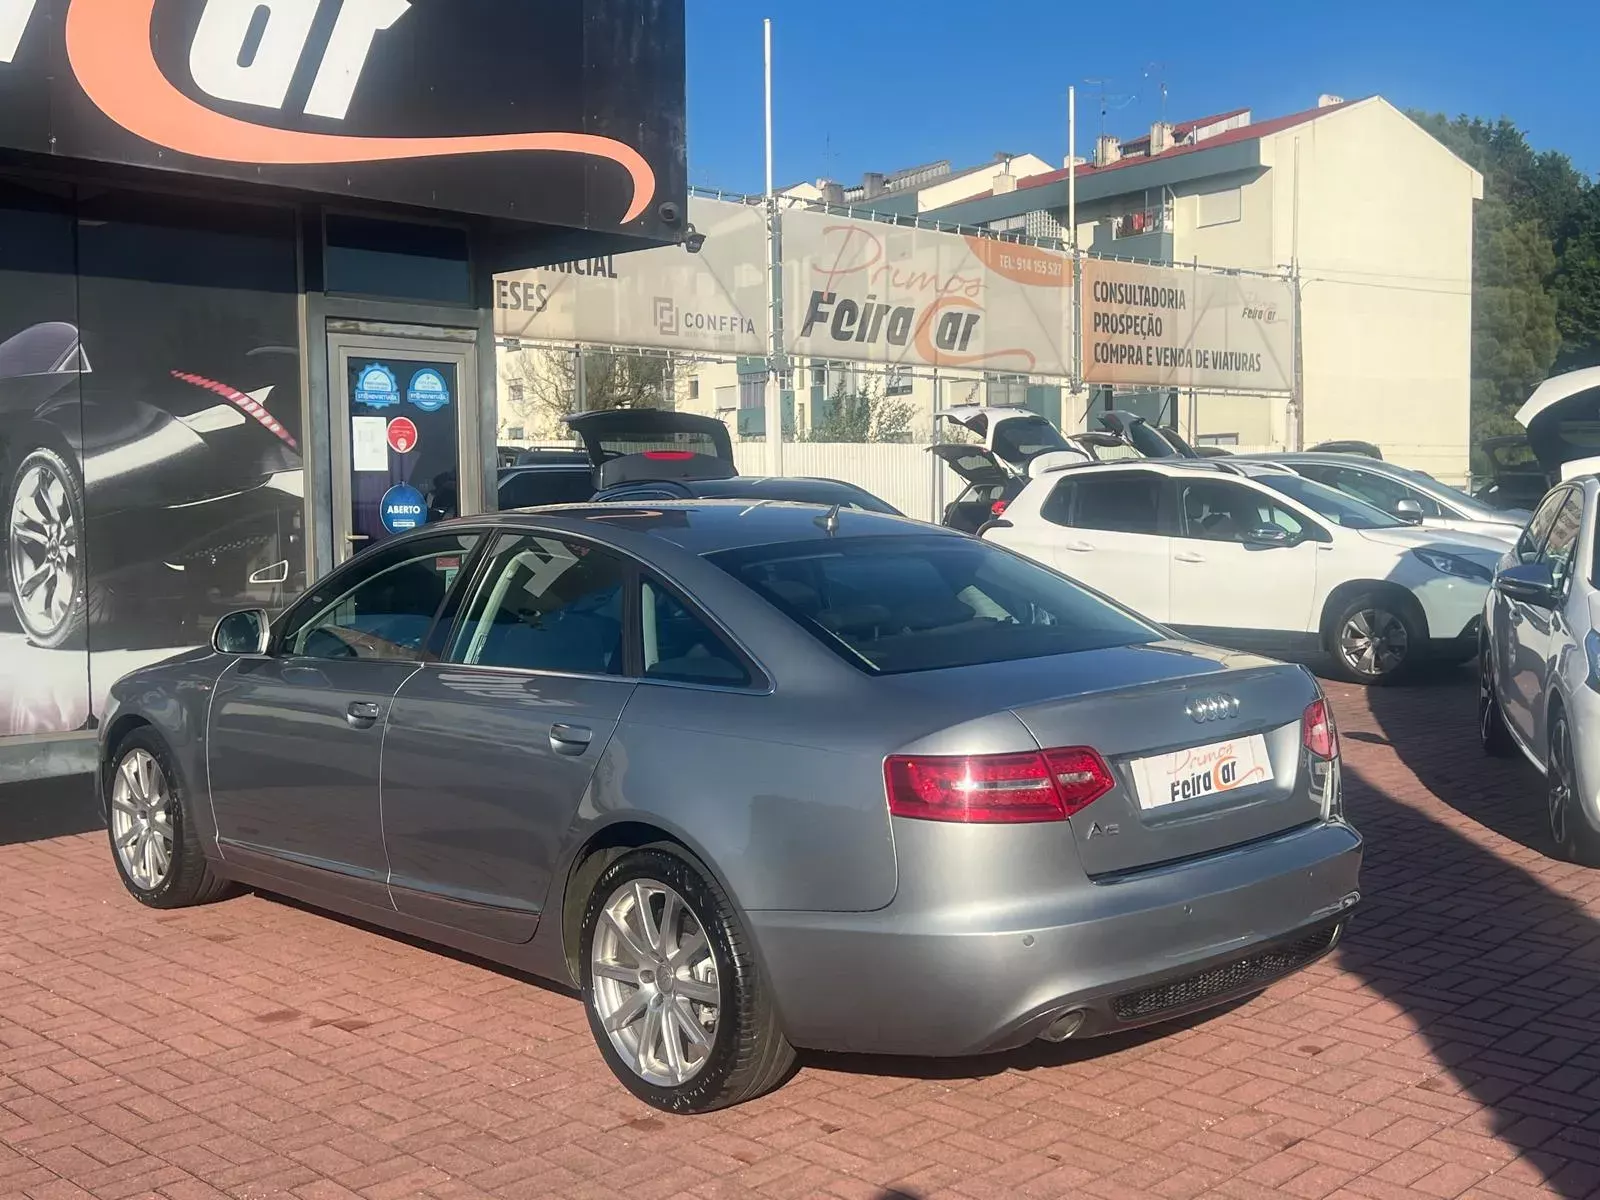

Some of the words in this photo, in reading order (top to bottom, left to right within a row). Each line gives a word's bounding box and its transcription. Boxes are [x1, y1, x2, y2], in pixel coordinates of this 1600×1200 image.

[811, 225, 989, 300] Primos
[496, 280, 548, 312] ESES
[1093, 280, 1187, 310] CONSULTADORIA
[685, 312, 756, 335] CONFFIA
[1093, 311, 1163, 340] PROSPEÇÃO
[1093, 342, 1144, 366] COMPRA
[1146, 346, 1153, 366] E
[1155, 347, 1193, 369] VENDA
[1195, 349, 1209, 370] DE
[1211, 350, 1262, 373] VIATURAS
[387, 505, 421, 514] ABERTO
